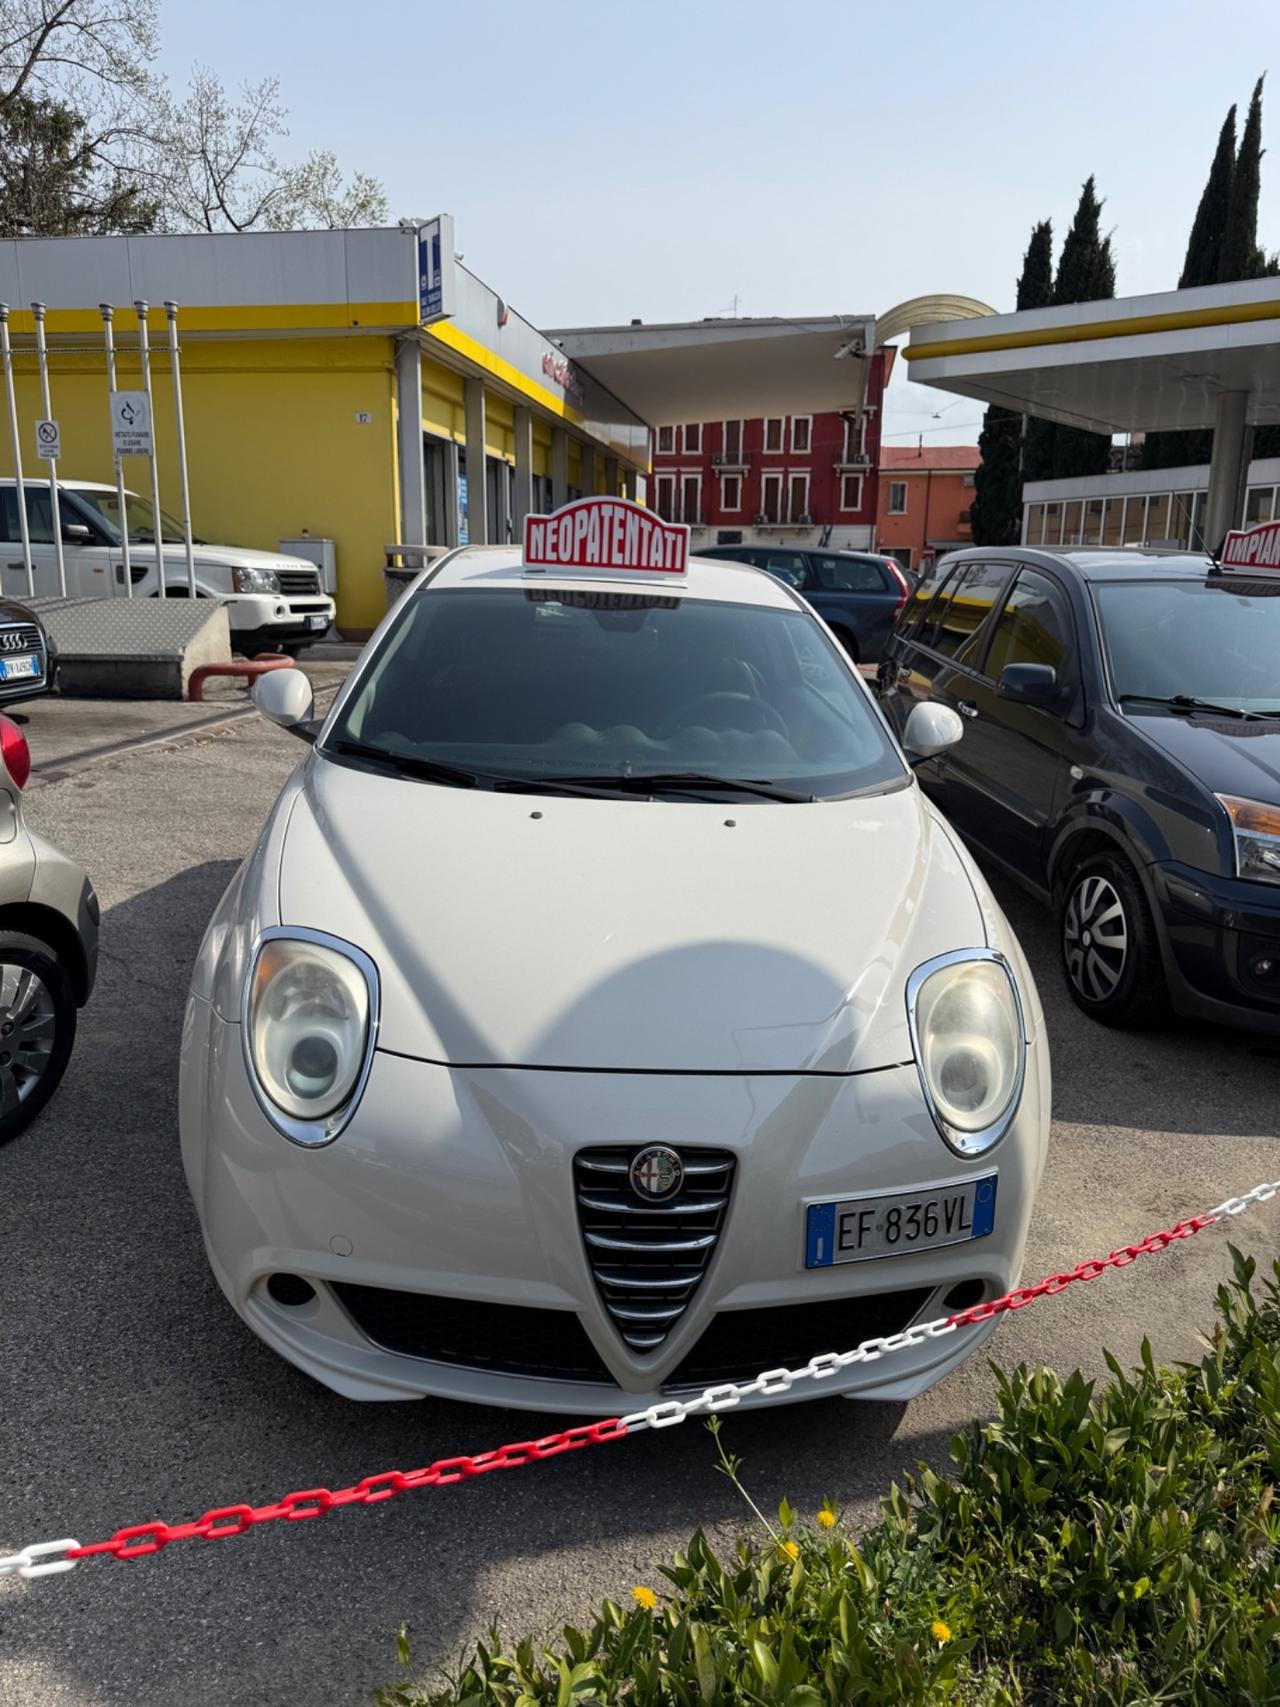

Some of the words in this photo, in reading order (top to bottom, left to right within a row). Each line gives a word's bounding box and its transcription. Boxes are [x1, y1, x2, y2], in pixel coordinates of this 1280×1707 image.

[529, 504, 684, 569] NEOPATENTATI
[838, 1210, 876, 1251] EF
[885, 1195, 972, 1245] 836VL
